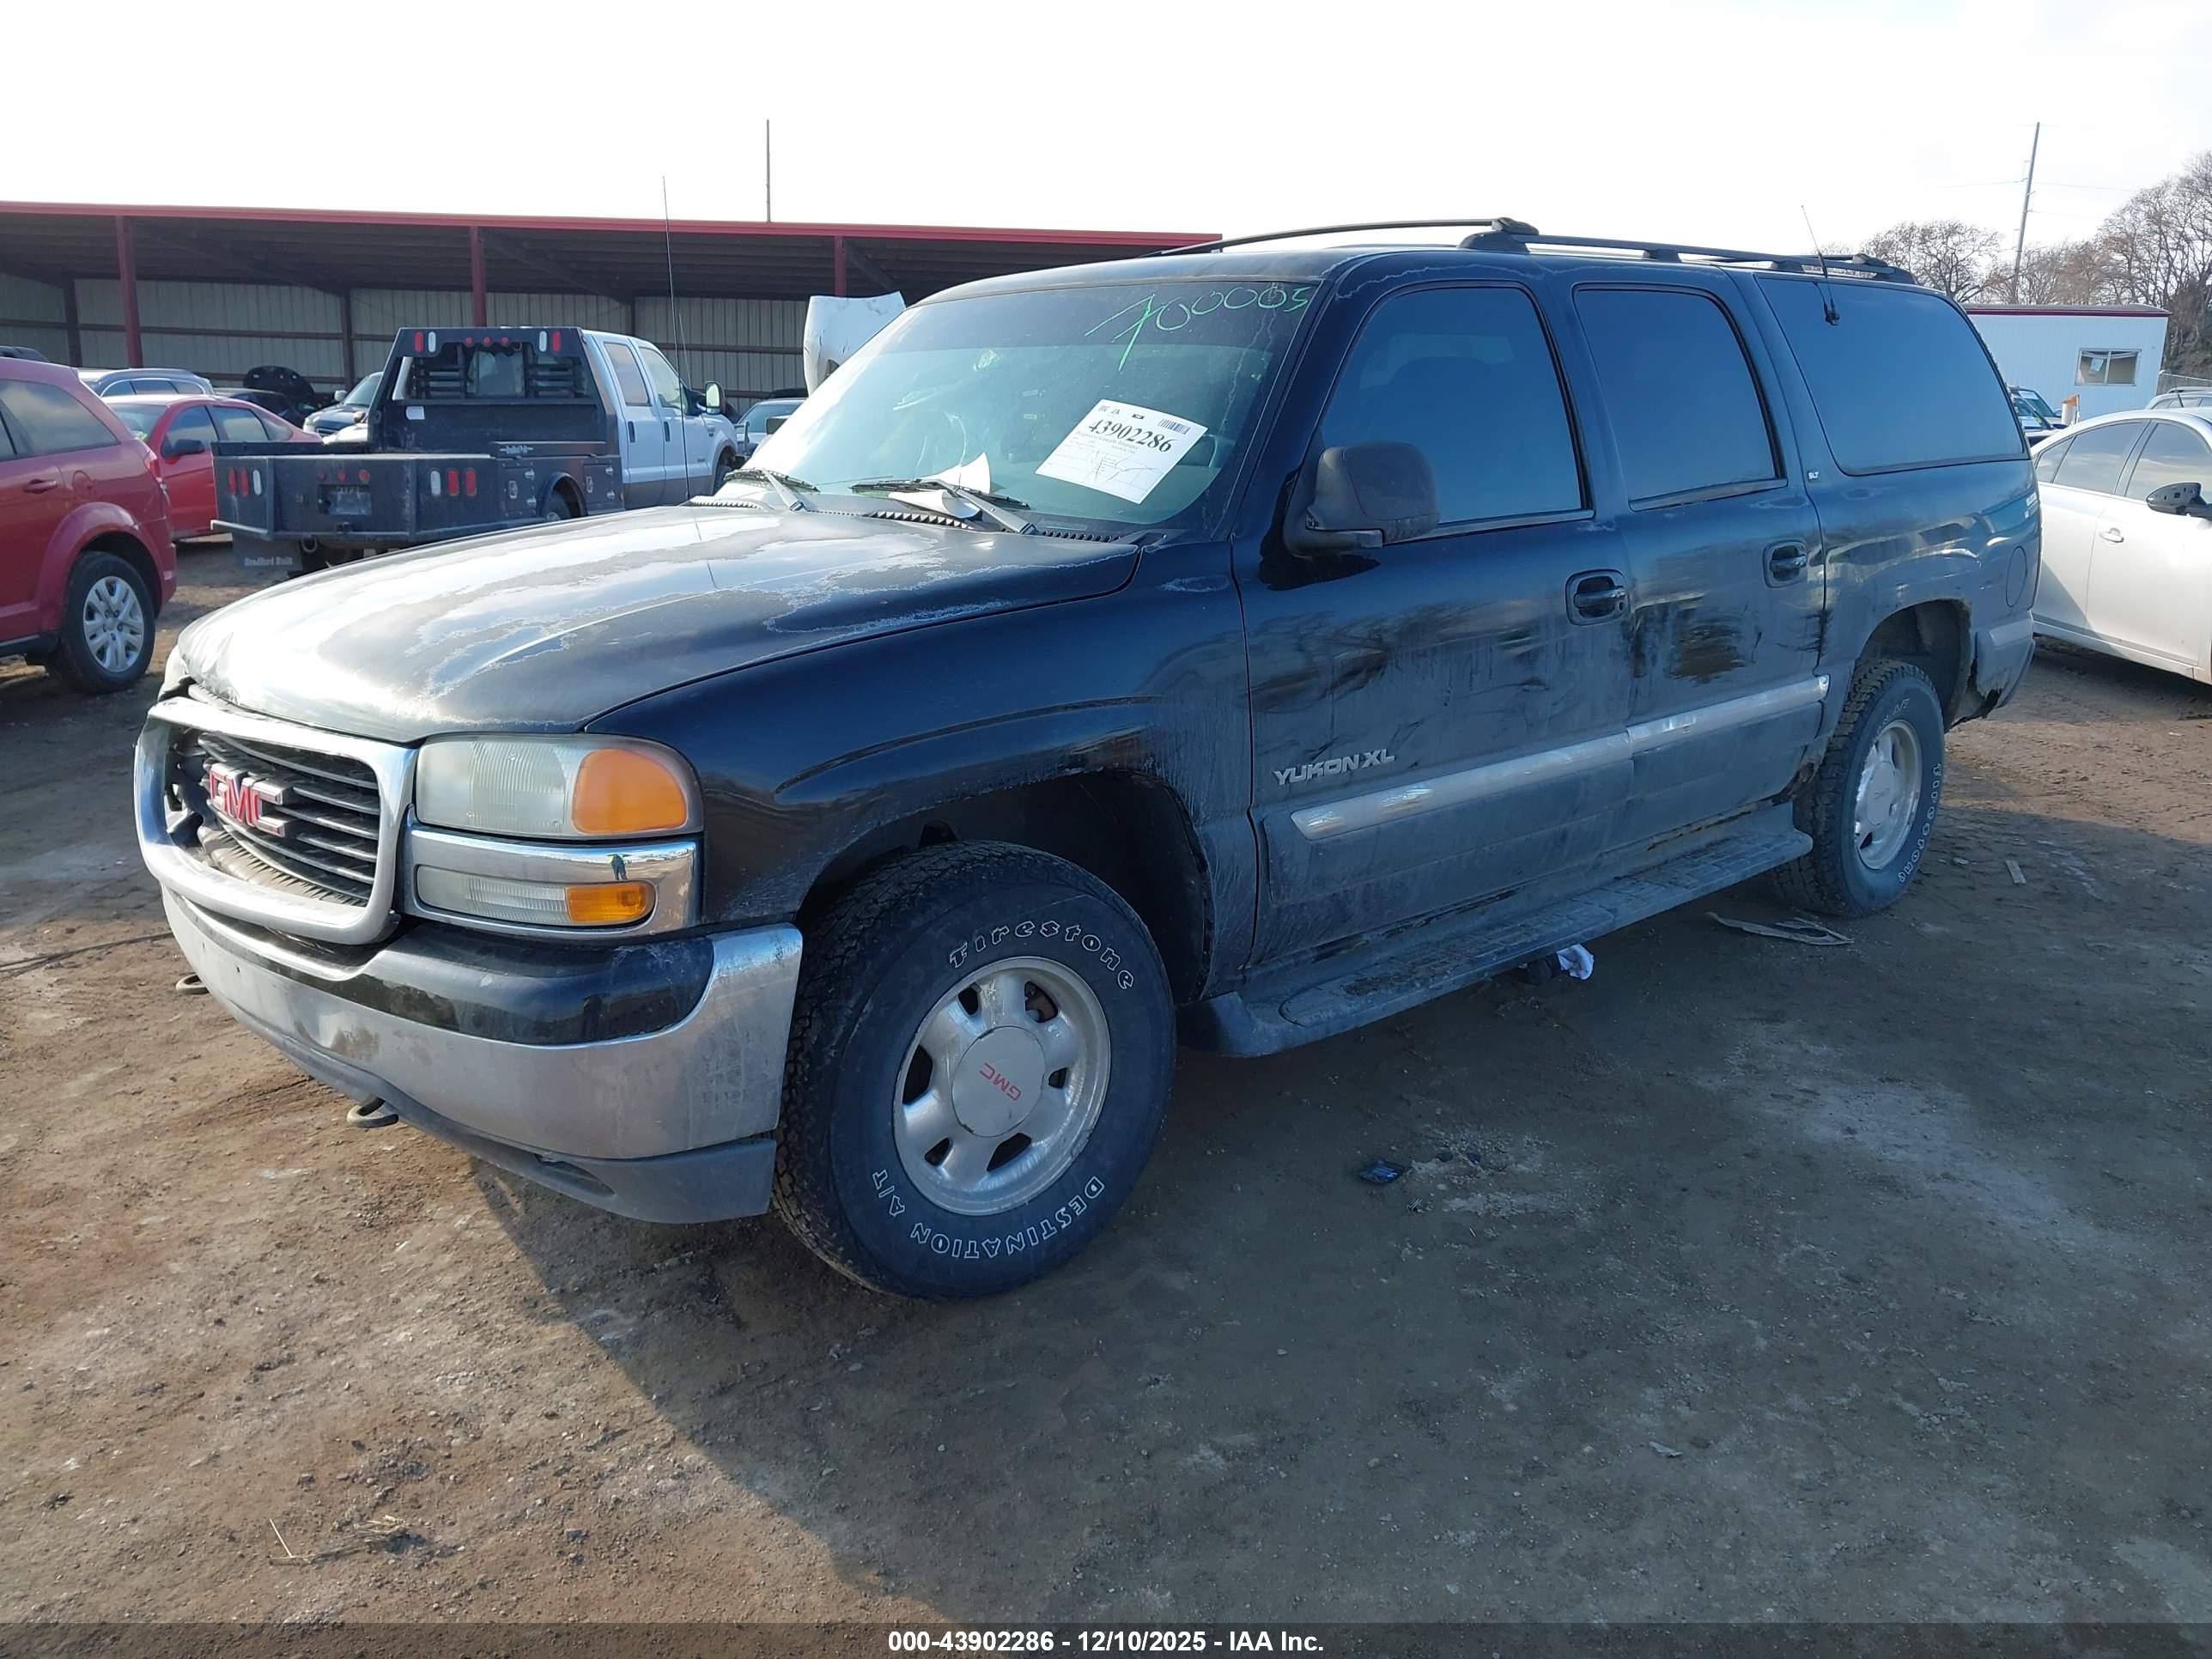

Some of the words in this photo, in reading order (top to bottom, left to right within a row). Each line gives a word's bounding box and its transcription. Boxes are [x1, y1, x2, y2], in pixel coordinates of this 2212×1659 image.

[1089, 419, 1178, 453] 43902286
[1273, 754, 1359, 786] YUKON
[1361, 749, 1395, 769] XL
[209, 763, 285, 837] GMC
[948, 920, 1135, 991] Firestone
[978, 1061, 1022, 1102] GMC
[872, 1167, 907, 1218] A/T
[909, 1176, 1106, 1261] DESTINATION
